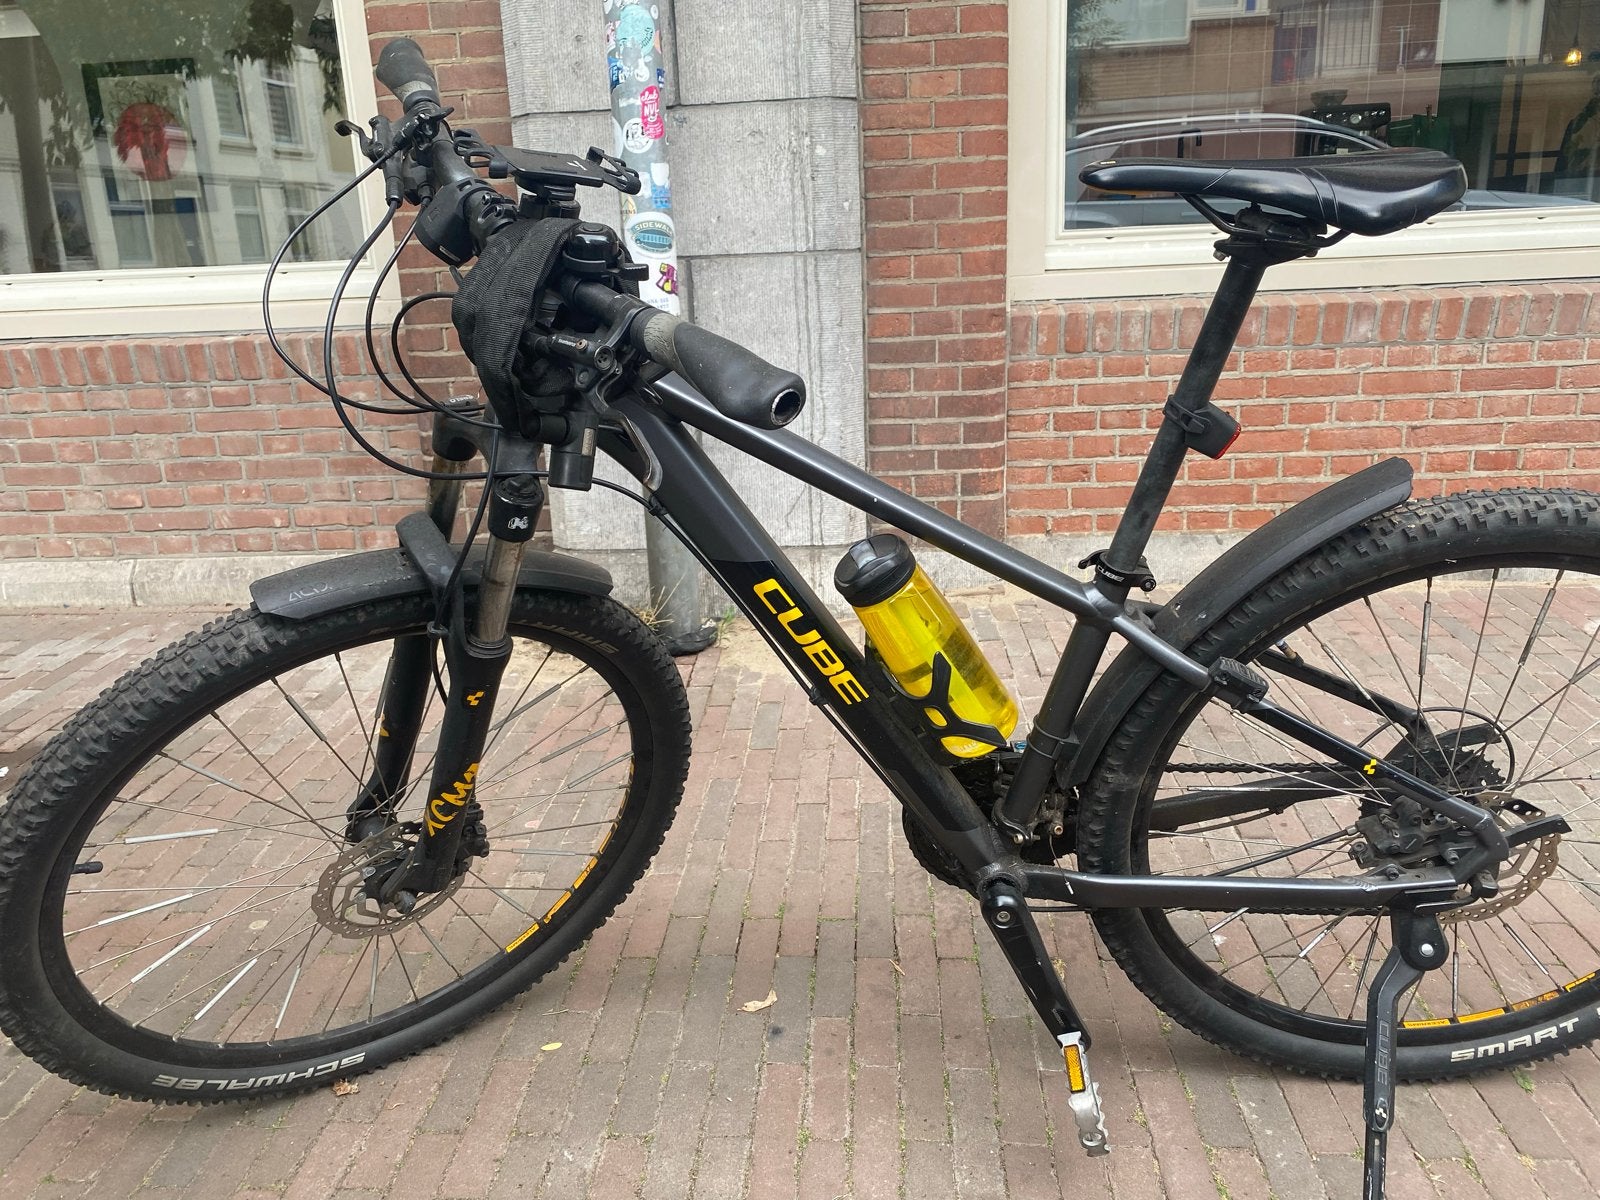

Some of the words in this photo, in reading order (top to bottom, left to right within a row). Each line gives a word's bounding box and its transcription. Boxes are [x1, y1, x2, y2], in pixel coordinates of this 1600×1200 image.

[1097, 564, 1125, 583] CUBE
[753, 577, 870, 706] CUBE
[1376, 1021, 1391, 1087] CUBE
[1450, 1016, 1580, 1063] SMART
[151, 1051, 367, 1092] SCHWALBE
